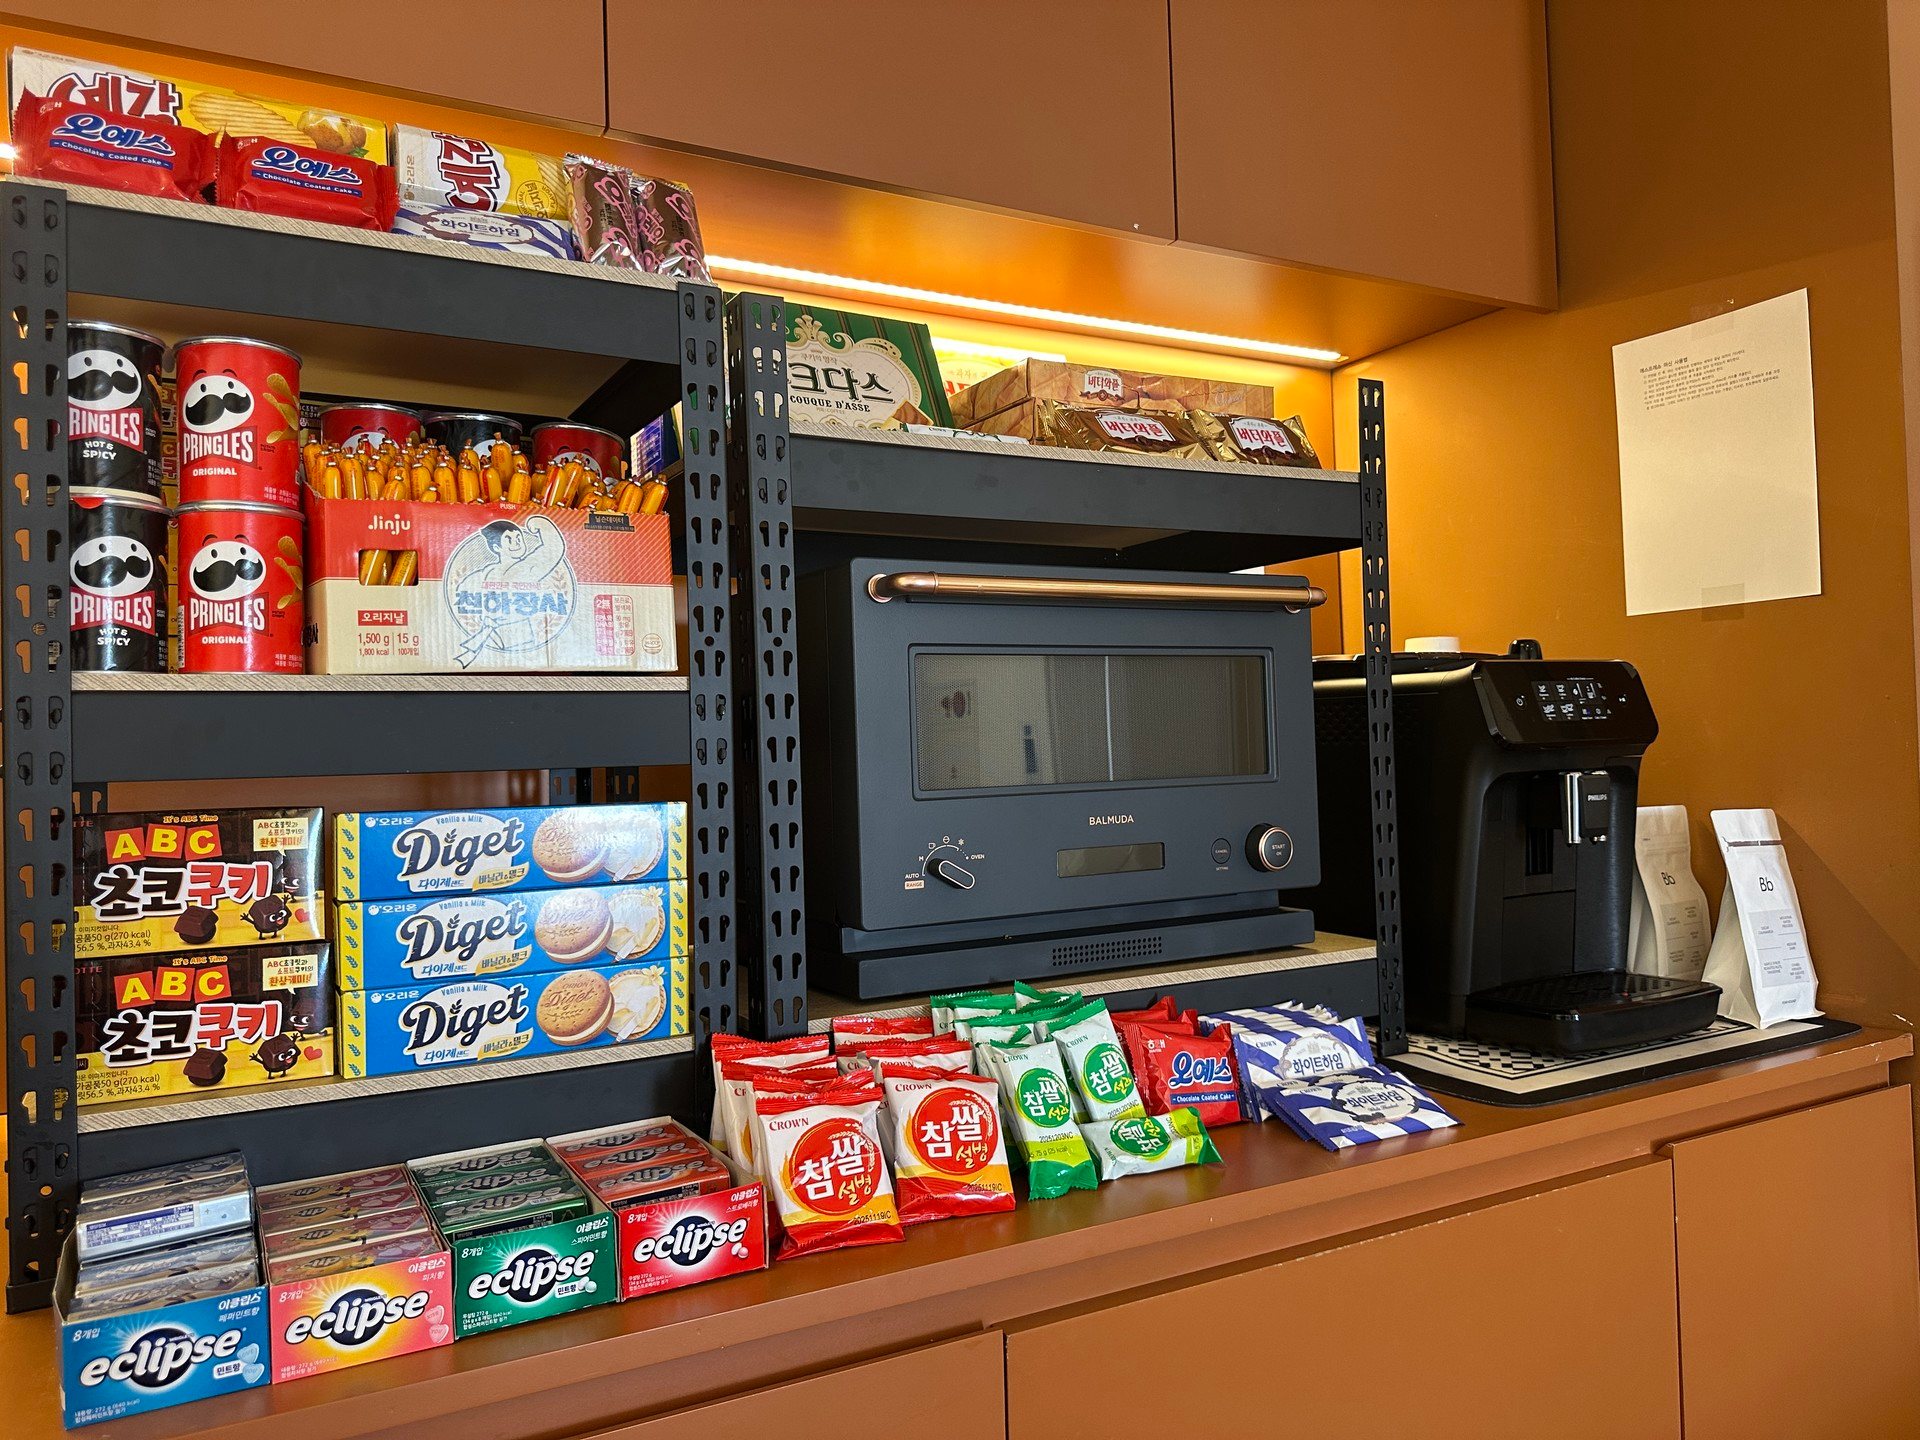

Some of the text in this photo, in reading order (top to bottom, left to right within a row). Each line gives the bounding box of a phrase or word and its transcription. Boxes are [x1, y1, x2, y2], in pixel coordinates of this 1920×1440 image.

[53, 113, 176, 156] 오예스
[62, 142, 162, 166] Chocolate Coated Cake
[252, 146, 362, 185] 오예스
[406, 153, 415, 190] 오리온
[432, 132, 494, 211] 예감
[263, 173, 353, 194] Chocolate Coated Cake
[440, 217, 520, 239] 화이트하임
[787, 362, 895, 402] 크다스
[1088, 375, 1120, 391] 버터와플
[789, 395, 871, 413] COUQUE D'ASSE
[69, 407, 140, 447] RINGLES
[1105, 420, 1163, 438] 버터와플
[85, 440, 104, 449] HOT
[1236, 427, 1285, 447] 버터와플
[82, 449, 117, 461] SPICY
[183, 429, 253, 465] PRINGLES
[192, 467, 237, 477] ORIGINAL
[368, 513, 411, 535] Jinju
[70, 592, 153, 630] PRINGLES
[454, 589, 569, 617] 천하장사
[190, 597, 265, 631] PRINGLES
[361, 611, 405, 625] 오리지날
[97, 635, 131, 647] SPICY
[100, 627, 119, 637] HOT
[201, 635, 249, 645] ORIGINAL
[358, 633, 420, 647] 1,500 g 15 g
[358, 648, 390, 657] 1,800 kcal
[163, 813, 219, 824] It's ABC Time
[378, 817, 414, 826] 오리온
[435, 815, 484, 825] Vanilla Milk
[1089, 814, 1134, 826] BALMUDA
[112, 829, 215, 859] ABC
[396, 819, 525, 878] Diget
[1660, 872, 1676, 886] Bb
[1758, 877, 1774, 892] Bb
[95, 864, 267, 918] 초코쿠키
[382, 903, 418, 913] 오리온
[439, 899, 486, 910] Vanilla Milk
[76, 933, 103, 943] 공품50
[131, 929, 151, 939] kcal)
[400, 900, 527, 964] Diget
[76, 943, 95, 953] 56.5
[172, 955, 228, 966] It's ABC Time
[121, 971, 225, 1004] ABC
[441, 987, 465, 996] Vanilla
[472, 984, 488, 992] Milk
[562, 980, 590, 990] ORION
[384, 990, 420, 1000] 오리온
[548, 987, 599, 1009] Diget
[402, 985, 529, 1050] Diget
[106, 1004, 276, 1063] 초코쿠키
[1066, 1034, 1089, 1049] CROWN
[1002, 1054, 1029, 1064] CROWN
[1292, 1053, 1344, 1075] 화이트하임
[140, 1074, 160, 1083] kcal)
[1089, 1051, 1125, 1096] 참쌀
[1168, 1052, 1233, 1089] 오예스
[77, 1090, 104, 1100] 릿56.5
[895, 1083, 932, 1093] CROWN
[1023, 1077, 1060, 1117] 참쌀
[1177, 1095, 1200, 1103] Chocolate
[1346, 1089, 1405, 1108] 화이트하임
[769, 1116, 809, 1132] CROWN
[921, 1106, 985, 1159] 참쌀
[566, 1127, 664, 1151] eclipse
[422, 1150, 531, 1177] eclipse
[583, 1142, 686, 1169] eclipse
[955, 1142, 988, 1170] 설병
[597, 1160, 704, 1190] eclipse
[798, 1136, 867, 1200] 참쌀
[434, 1168, 547, 1195] eclipse
[838, 1174, 872, 1206] 설병
[445, 1186, 562, 1216] eclipse
[731, 1187, 760, 1203] 이클립스
[575, 1217, 609, 1234] 이클립스
[627, 1212, 648, 1224] 8개입
[570, 1230, 608, 1246] 스피어민트향
[633, 1218, 748, 1263] eclipse
[461, 1246, 484, 1258] 8개입
[408, 1258, 446, 1274] 이클립스
[468, 1251, 595, 1299] eclipse
[422, 1270, 445, 1281] 피치향
[279, 1289, 304, 1303] 8개입
[557, 1283, 577, 1296] 민트향
[218, 1292, 261, 1311] 이클립스
[285, 1291, 429, 1344] eclipse
[72, 1327, 101, 1343] 8개입
[80, 1329, 242, 1387] eclipse
[216, 1363, 241, 1375] 민트향
